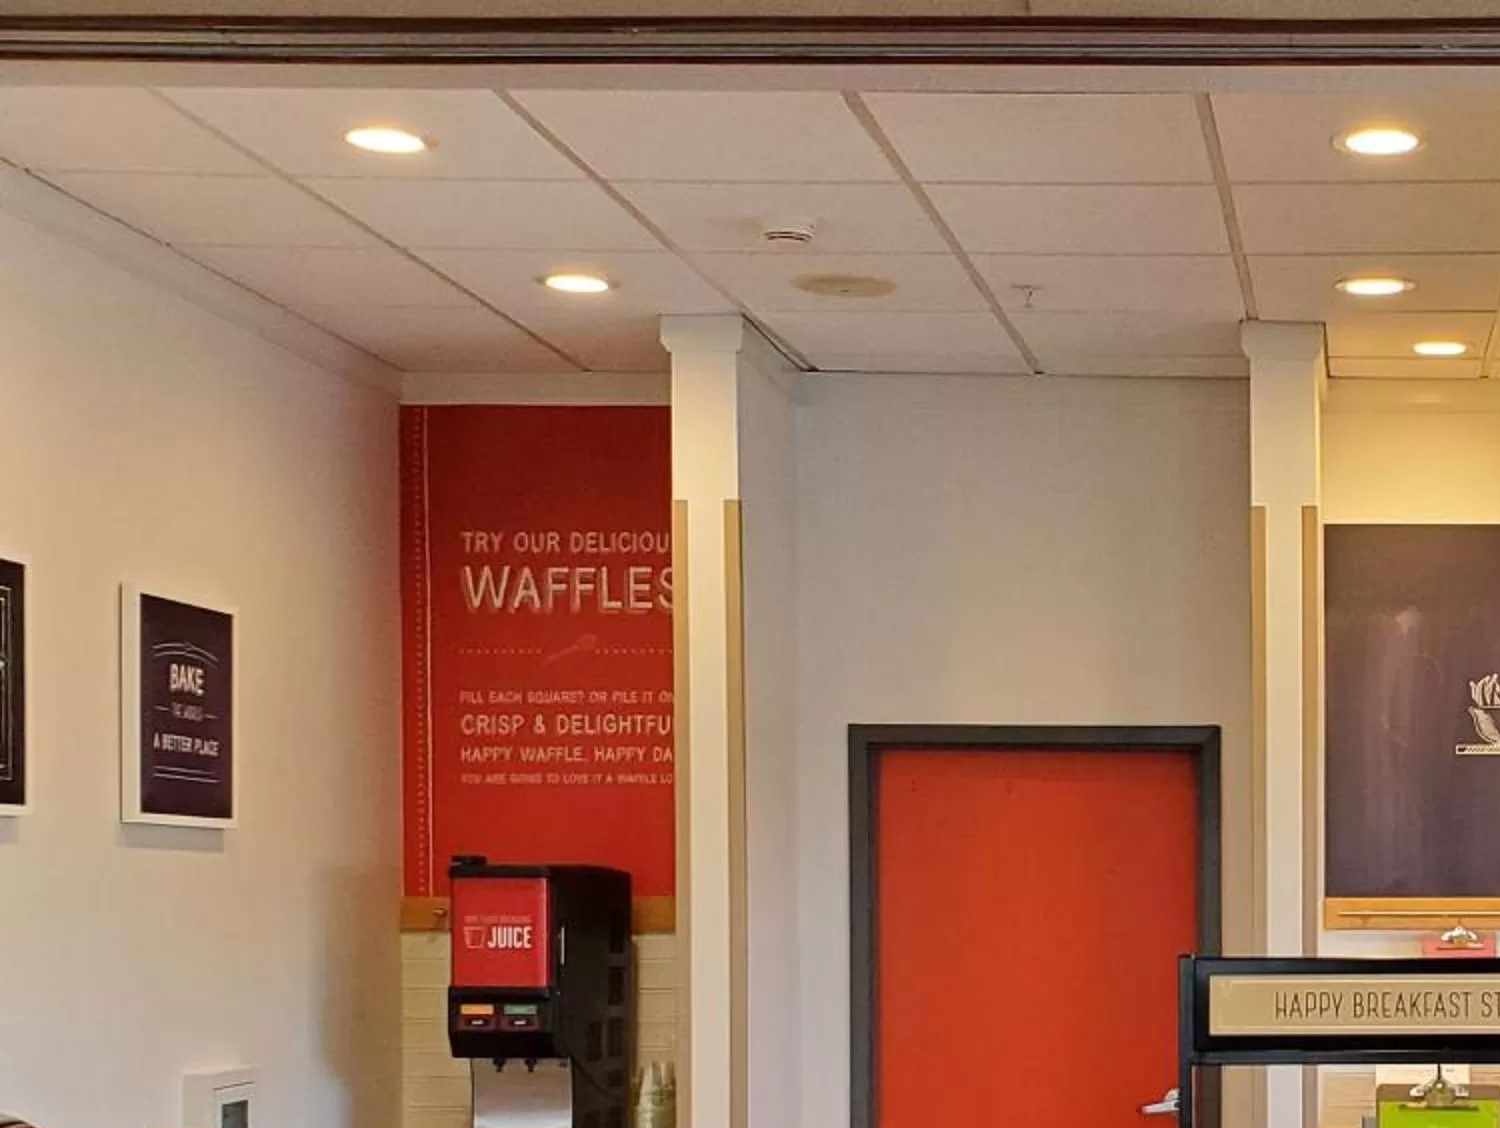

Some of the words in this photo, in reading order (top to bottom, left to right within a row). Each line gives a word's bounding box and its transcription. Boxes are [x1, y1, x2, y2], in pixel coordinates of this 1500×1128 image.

[461, 531, 502, 552] TRY
[513, 531, 560, 552] OUR
[570, 531, 670, 552] DELICIOU
[461, 565, 673, 613] WAFFLES
[169, 663, 205, 696] BAKE
[589, 690, 607, 704] OR
[460, 713, 525, 736] CRISP
[533, 713, 546, 735] &
[556, 713, 672, 736] DELIGHTFU
[161, 733, 193, 752] BETTER
[194, 736, 220, 757] PLACE
[460, 746, 513, 762] HAPPY
[594, 746, 645, 762] HAPPY
[653, 746, 673, 762] DA
[488, 926, 533, 949] JUICE
[1275, 991, 1343, 1019] HAPPY
[1353, 991, 1473, 1019] BREAKFAST
